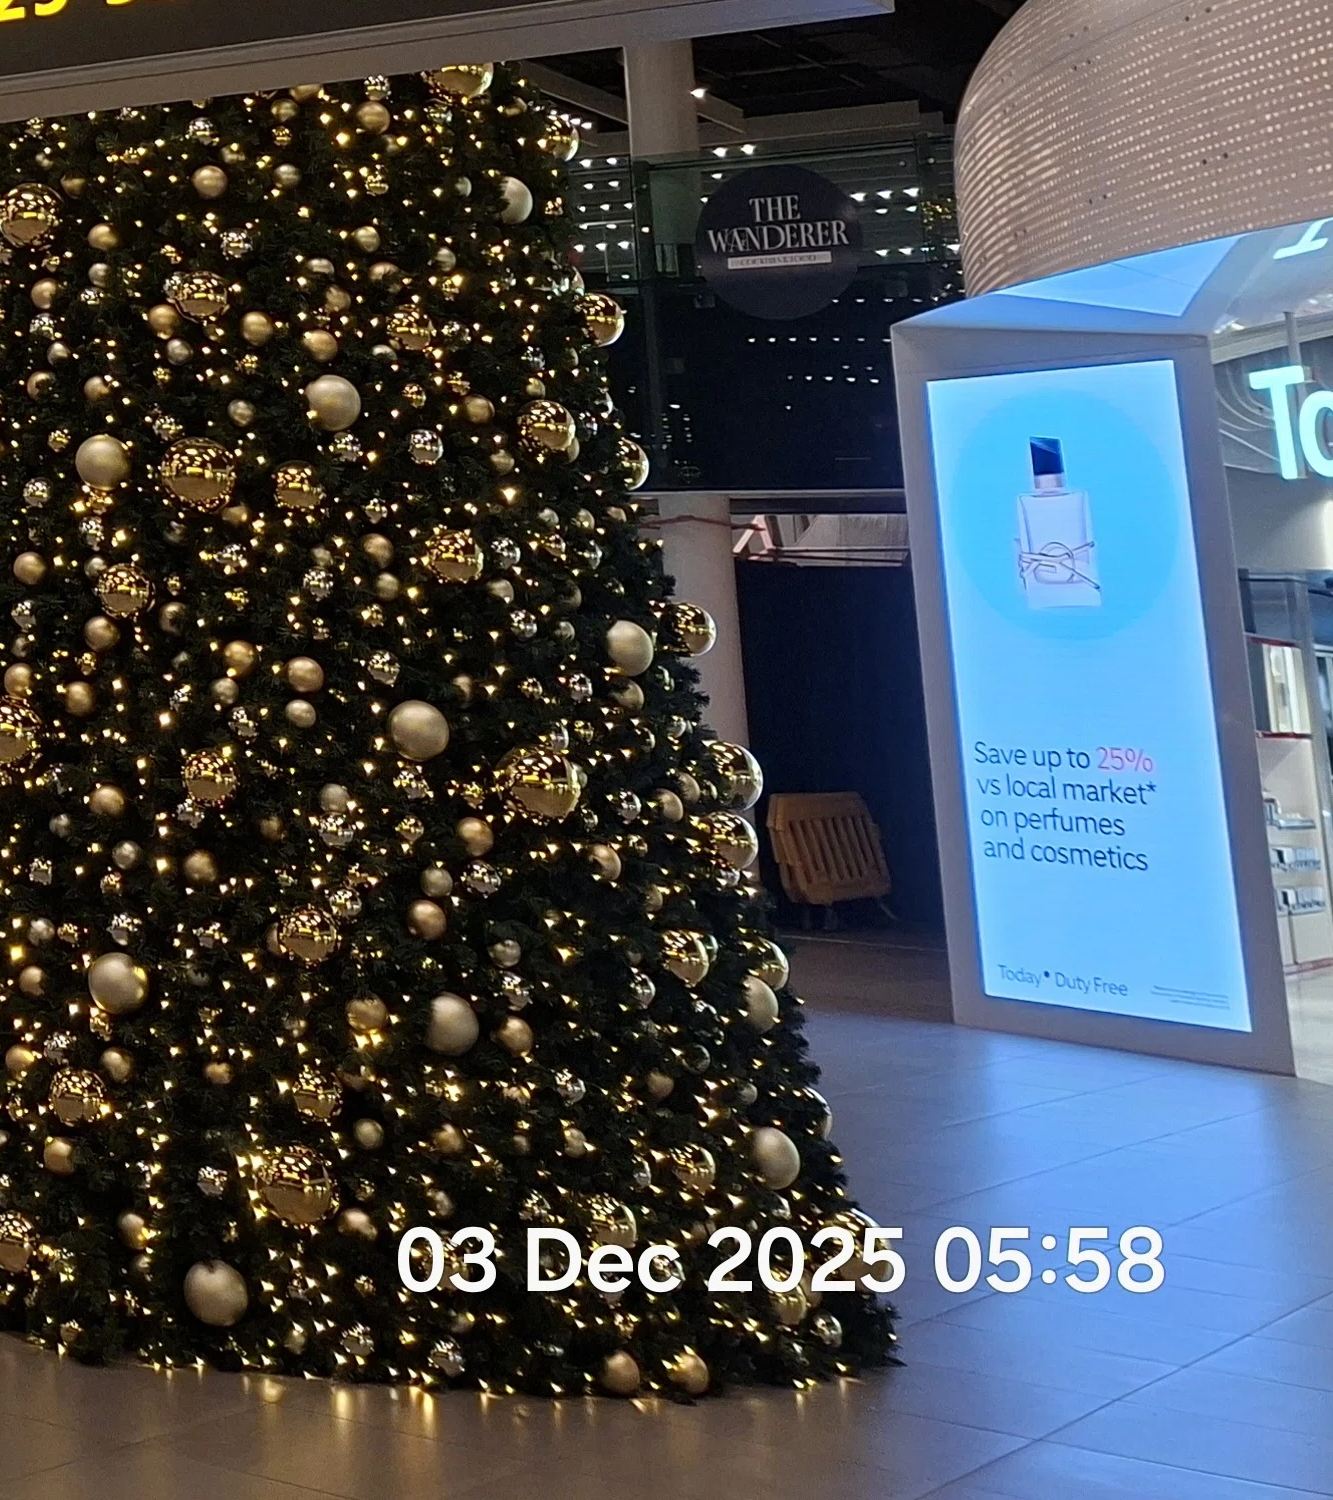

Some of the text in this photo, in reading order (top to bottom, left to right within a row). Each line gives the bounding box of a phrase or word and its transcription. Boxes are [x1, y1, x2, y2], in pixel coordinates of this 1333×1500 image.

[749, 195, 801, 222] THE
[707, 220, 849, 253] WANDERER
[974, 741, 1153, 772] Save up to 25%
[976, 778, 1001, 796] vs
[1006, 773, 1057, 799] local
[981, 808, 1125, 836] on perfumes
[983, 837, 1149, 871] and cosmetics
[997, 964, 1129, 996] Today Duty Free
